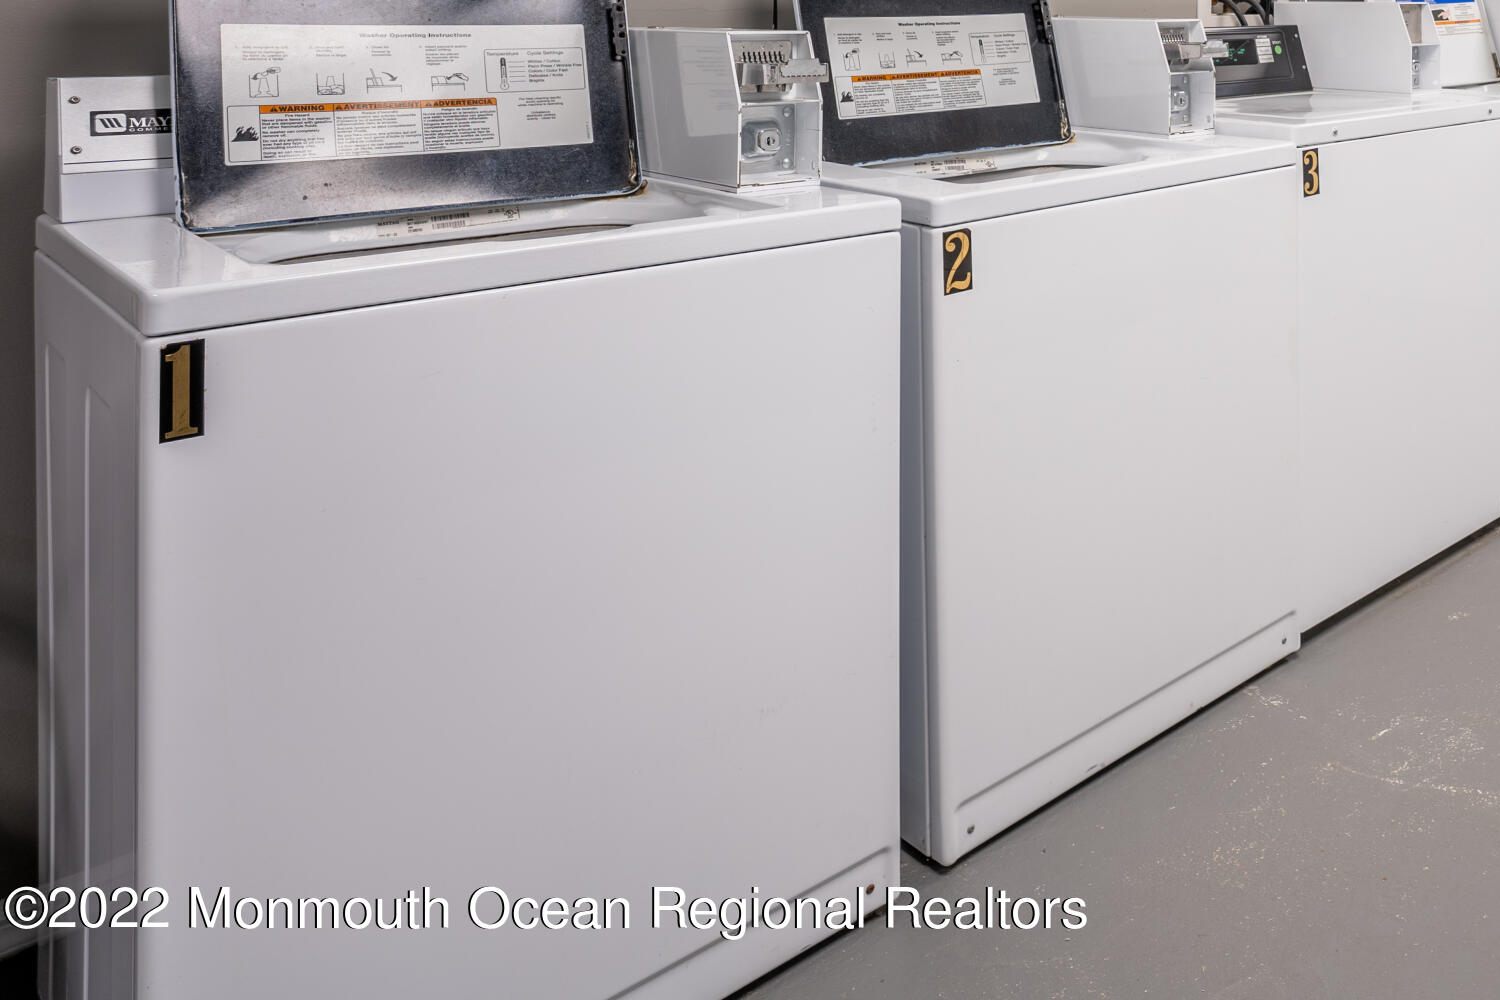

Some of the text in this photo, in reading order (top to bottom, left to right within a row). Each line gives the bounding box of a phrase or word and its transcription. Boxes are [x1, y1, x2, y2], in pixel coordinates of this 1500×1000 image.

[344, 102, 419, 110] AVERTISSEMENT
[1304, 150, 1318, 195] 3
[946, 232, 971, 293] 2
[165, 344, 198, 439] 1
